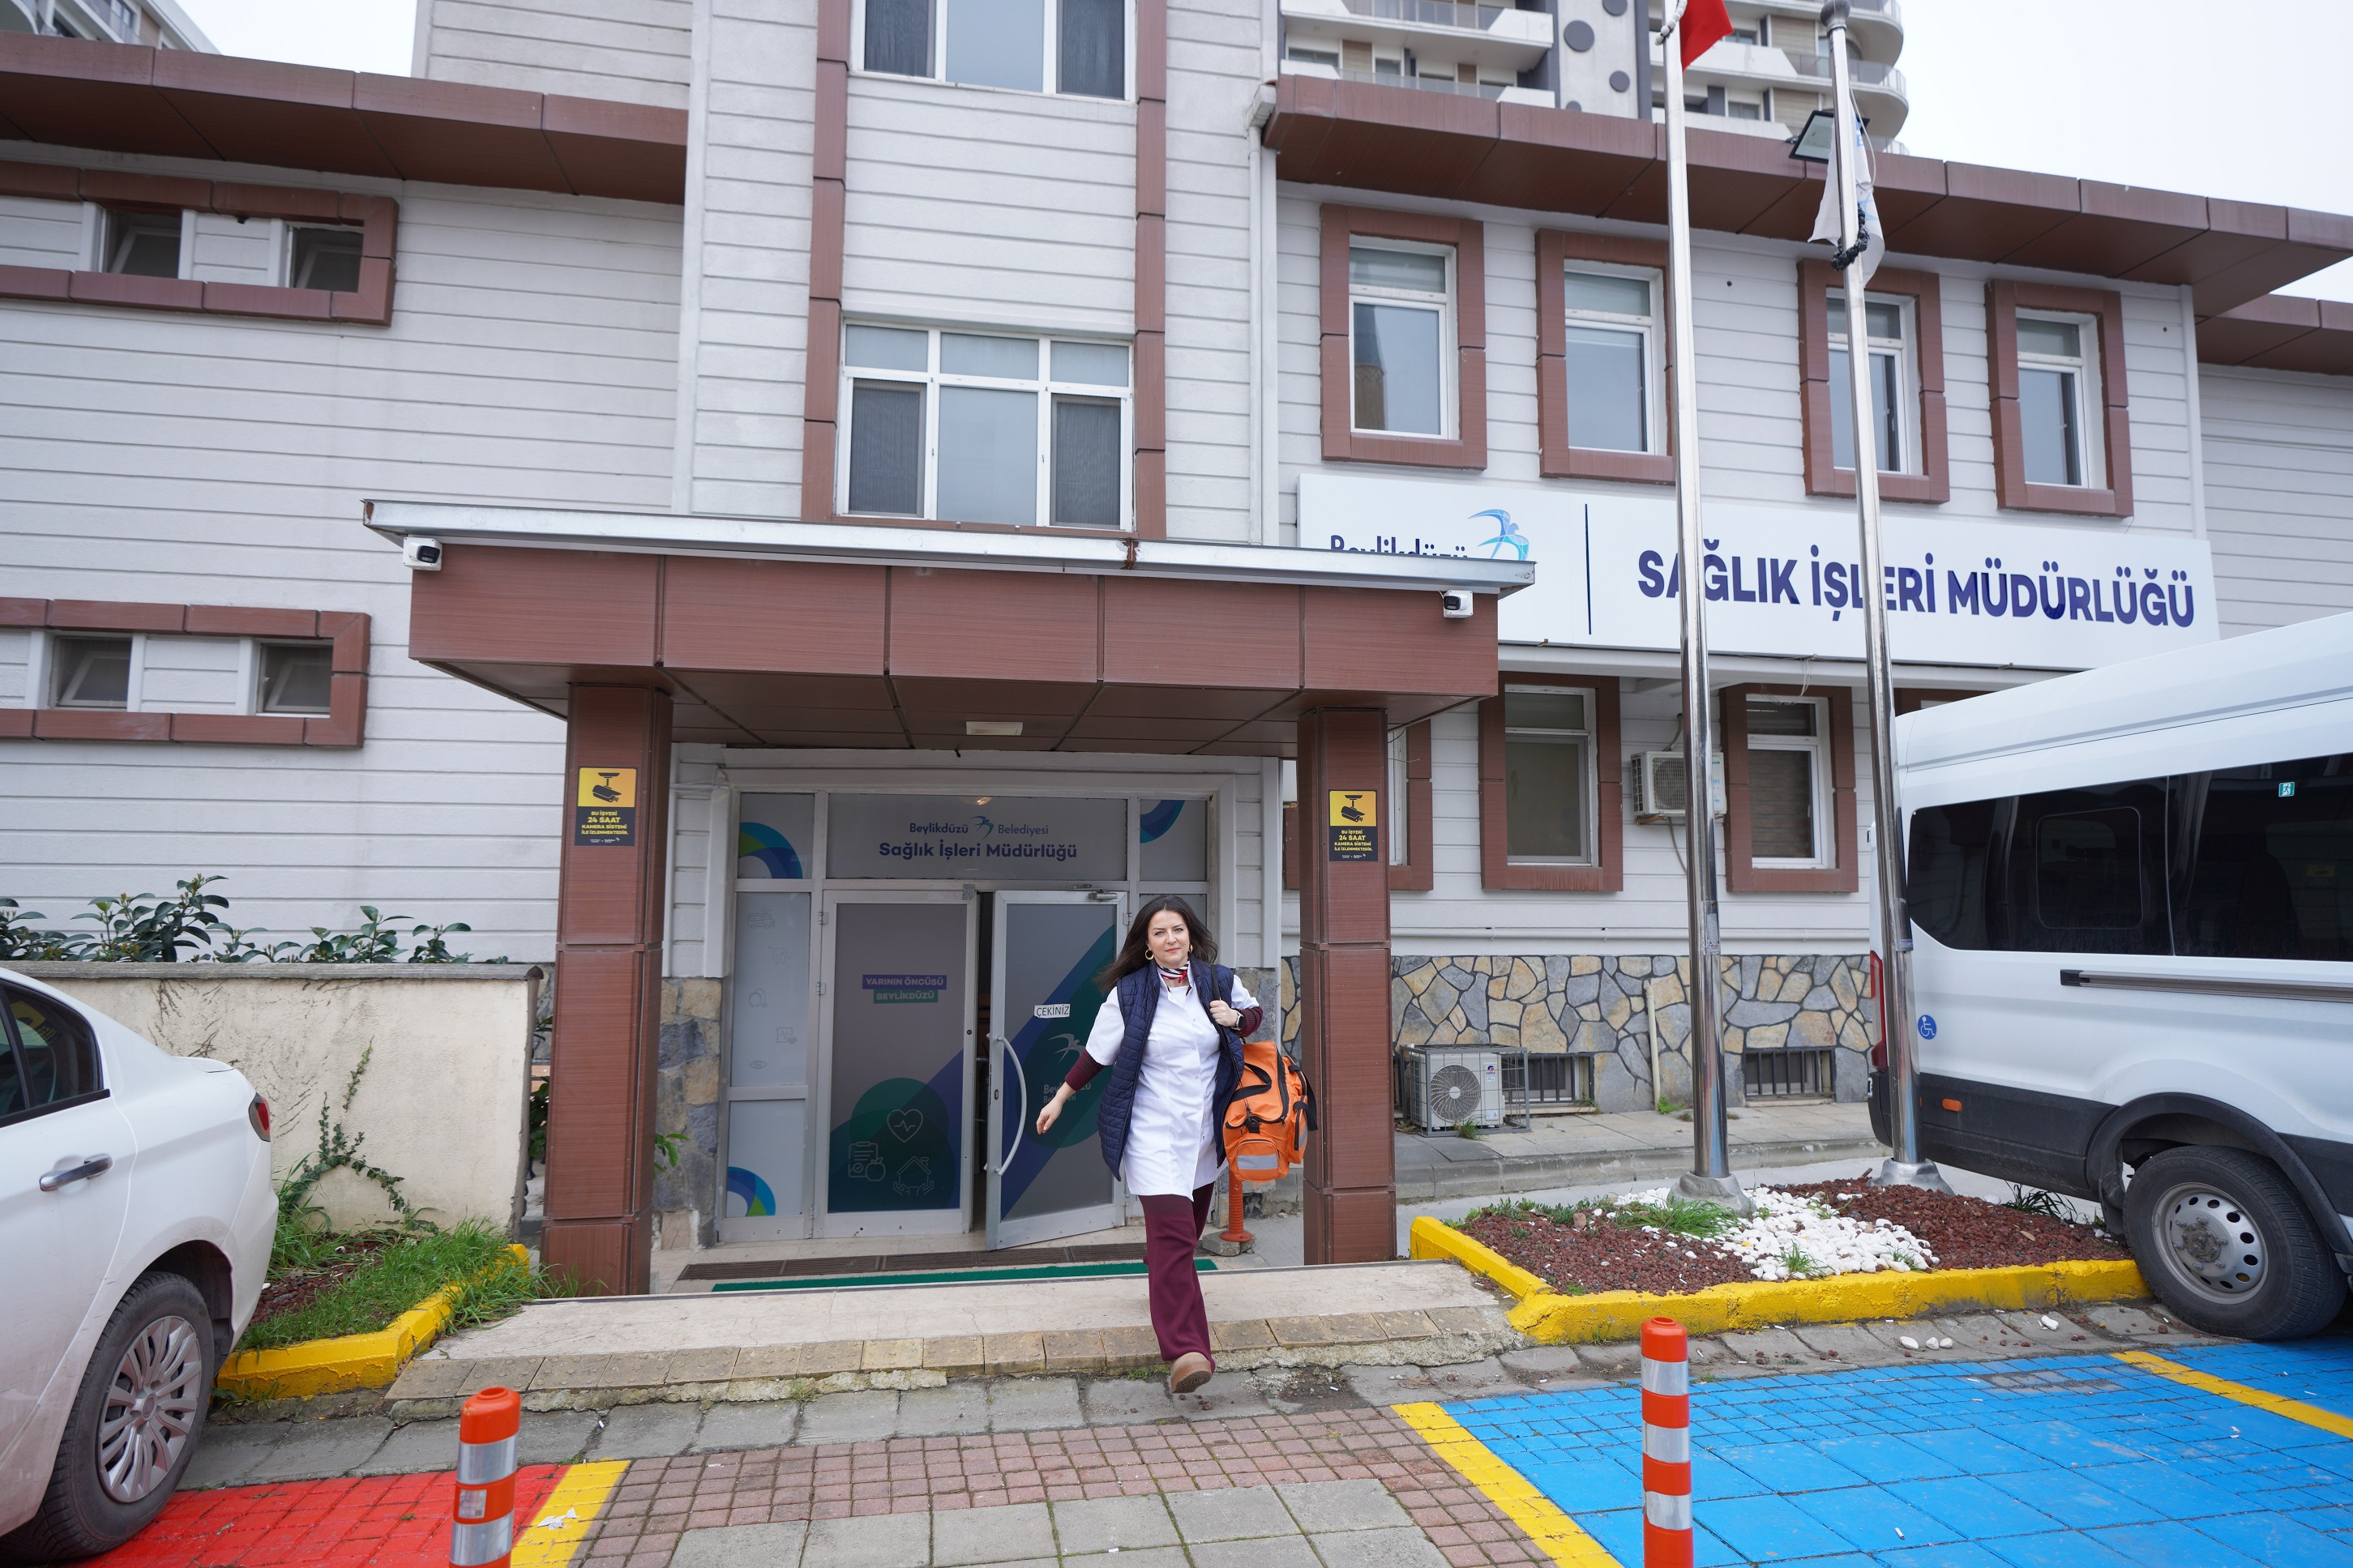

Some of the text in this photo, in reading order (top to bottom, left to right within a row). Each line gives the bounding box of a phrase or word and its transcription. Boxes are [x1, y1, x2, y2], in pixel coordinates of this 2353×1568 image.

[1810, 544, 1936, 622] İŞLERİ
[1947, 556, 2194, 628] MÜDÜRLÜĞÜ
[909, 822, 1049, 837] Beylikdüzü Belediyesi
[879, 839, 1077, 862] Sağlık İşleri Müdürlüğü
[866, 976, 943, 986] YARININ ÖNCÜSÜ
[876, 990, 935, 1001] BEYLİKDÜZÜ
[1036, 1005, 1070, 1017] ÇEKİNİZ
